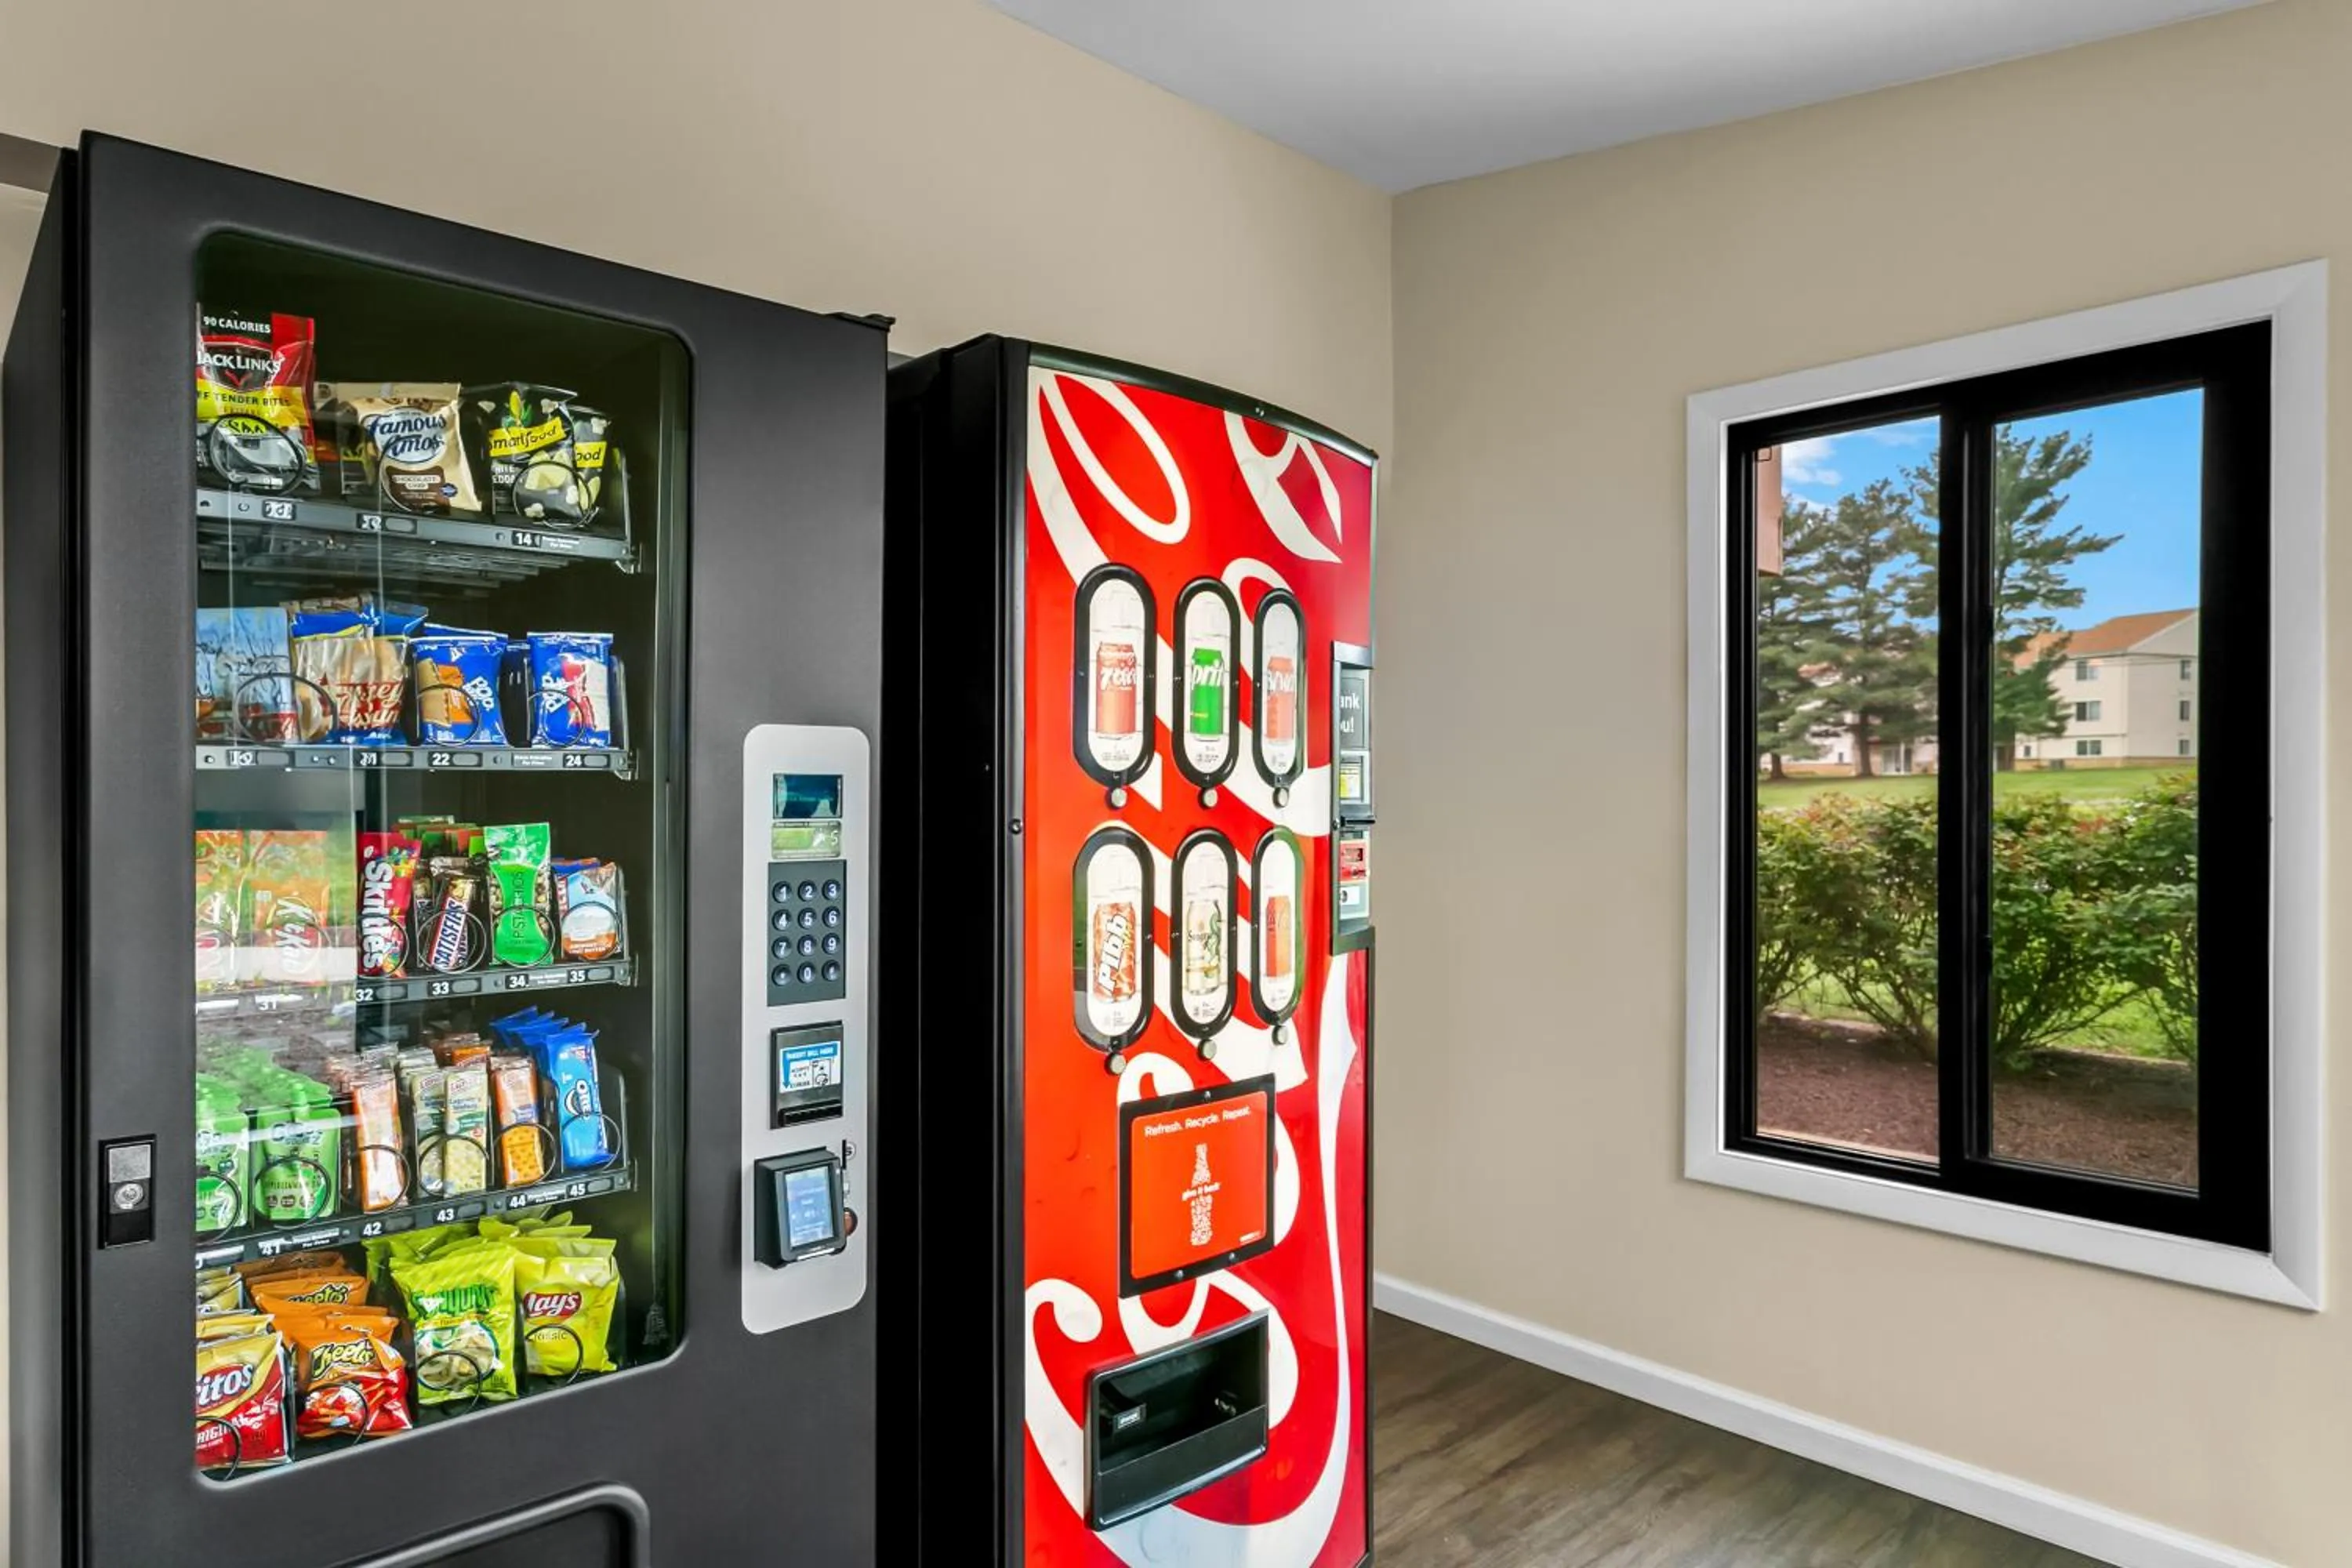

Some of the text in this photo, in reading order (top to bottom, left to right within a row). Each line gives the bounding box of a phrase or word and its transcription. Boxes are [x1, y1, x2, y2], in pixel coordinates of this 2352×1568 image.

[203, 316, 271, 333] 90 CALORIES
[515, 532, 532, 546] 14
[1341, 690, 1360, 709] ank
[1341, 717, 1355, 733] ou!
[432, 753, 450, 765] 22
[565, 754, 583, 767] 24
[780, 884, 837, 900] 1 2 3
[361, 861, 393, 969] Skittles
[779, 910, 837, 926] 4 5 6
[779, 938, 837, 956] 7 8 9
[509, 975, 526, 989] 34
[570, 971, 586, 982] 35
[804, 967, 811, 982] 0
[355, 989, 373, 1002] 32
[432, 982, 449, 995] 33
[570, 1185, 586, 1196] 45
[510, 1195, 526, 1207] 44
[437, 1209, 455, 1221] 43
[362, 1221, 382, 1236] 42
[527, 1291, 580, 1316] Lay's
[313, 1341, 375, 1377] Cheetos
